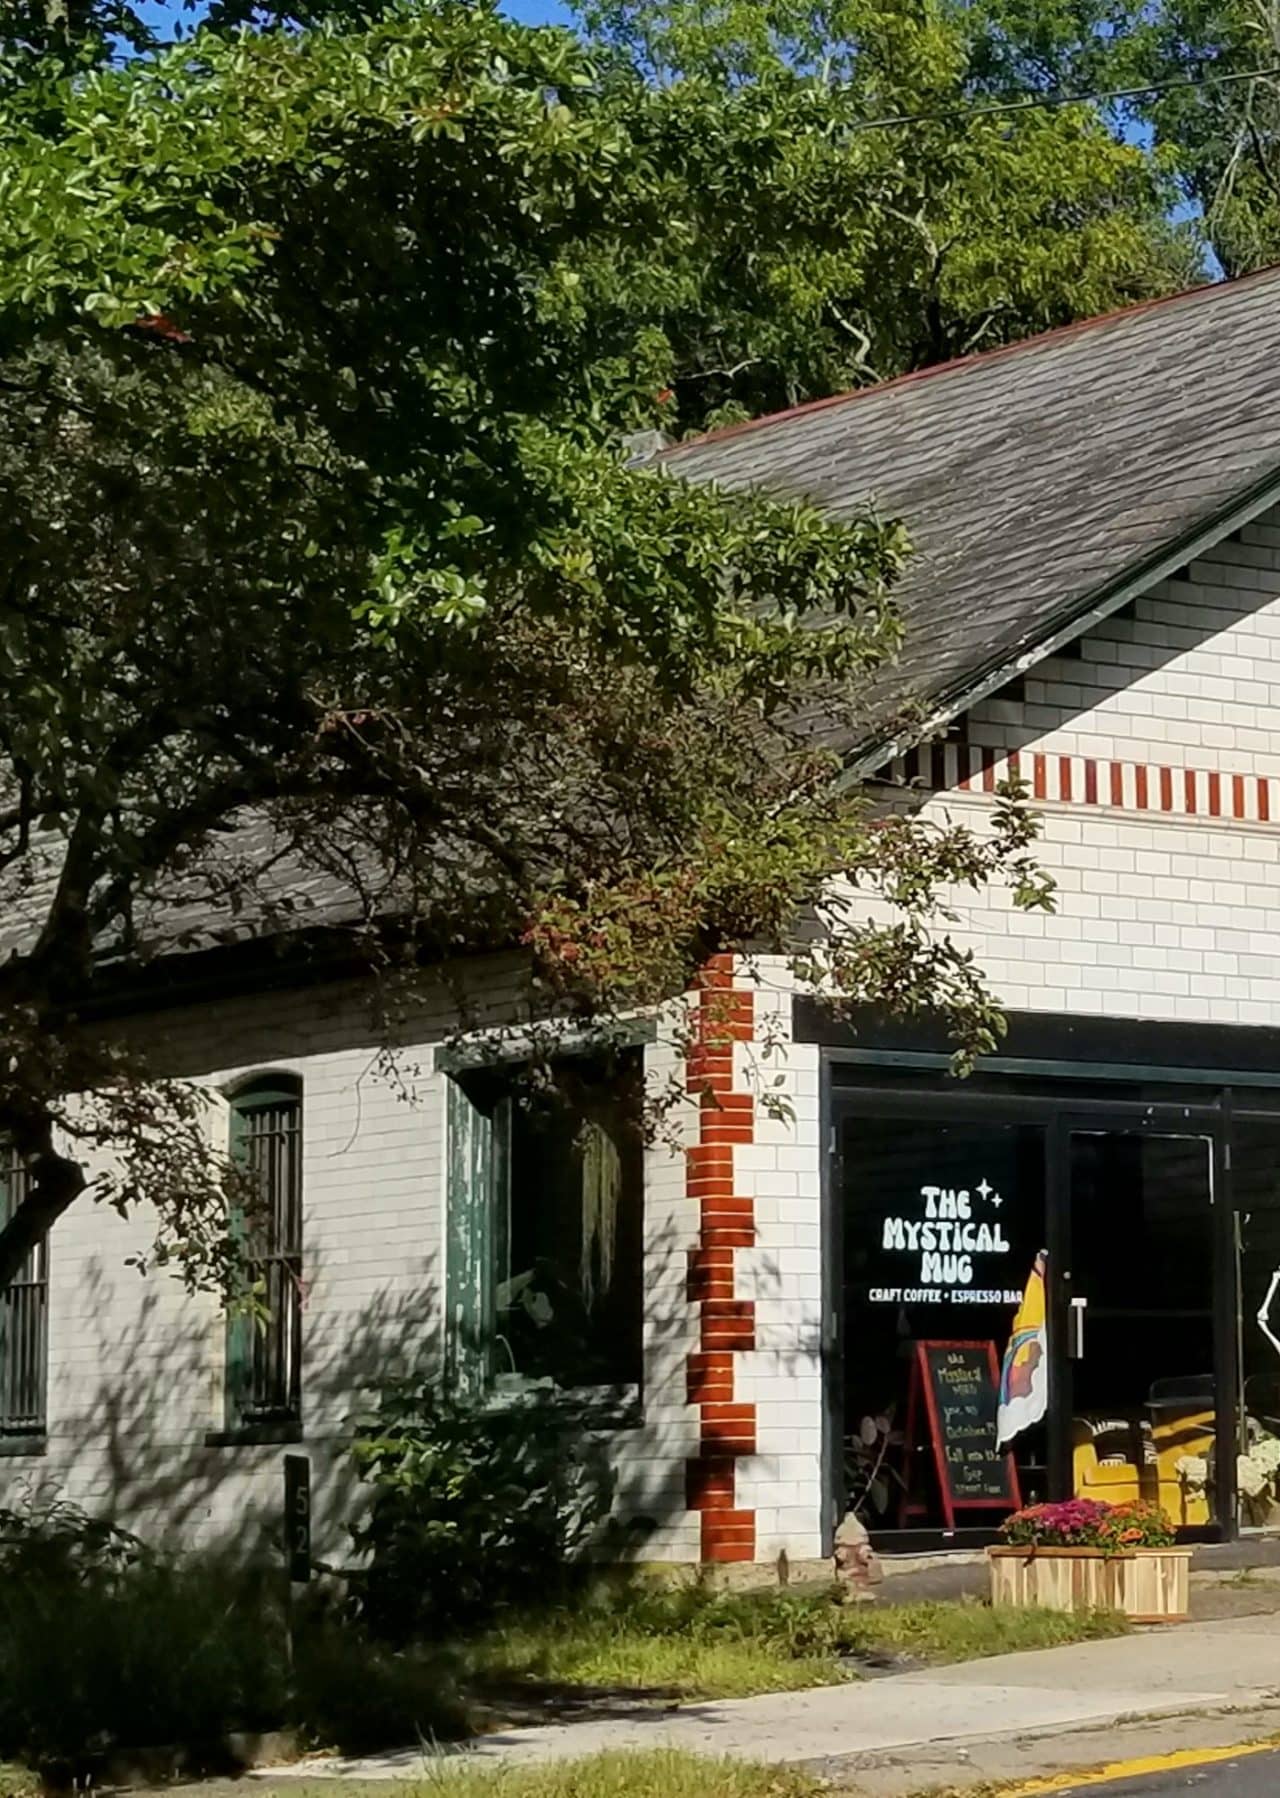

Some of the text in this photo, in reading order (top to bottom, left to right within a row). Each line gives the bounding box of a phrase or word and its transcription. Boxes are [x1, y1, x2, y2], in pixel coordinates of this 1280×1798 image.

[920, 1186, 972, 1219] THE
[882, 1217, 1010, 1252] MYSTICAL
[920, 1251, 973, 1284] MUG
[868, 1288, 1024, 1304] CRAFT COFFEE ESPRESSO BAR
